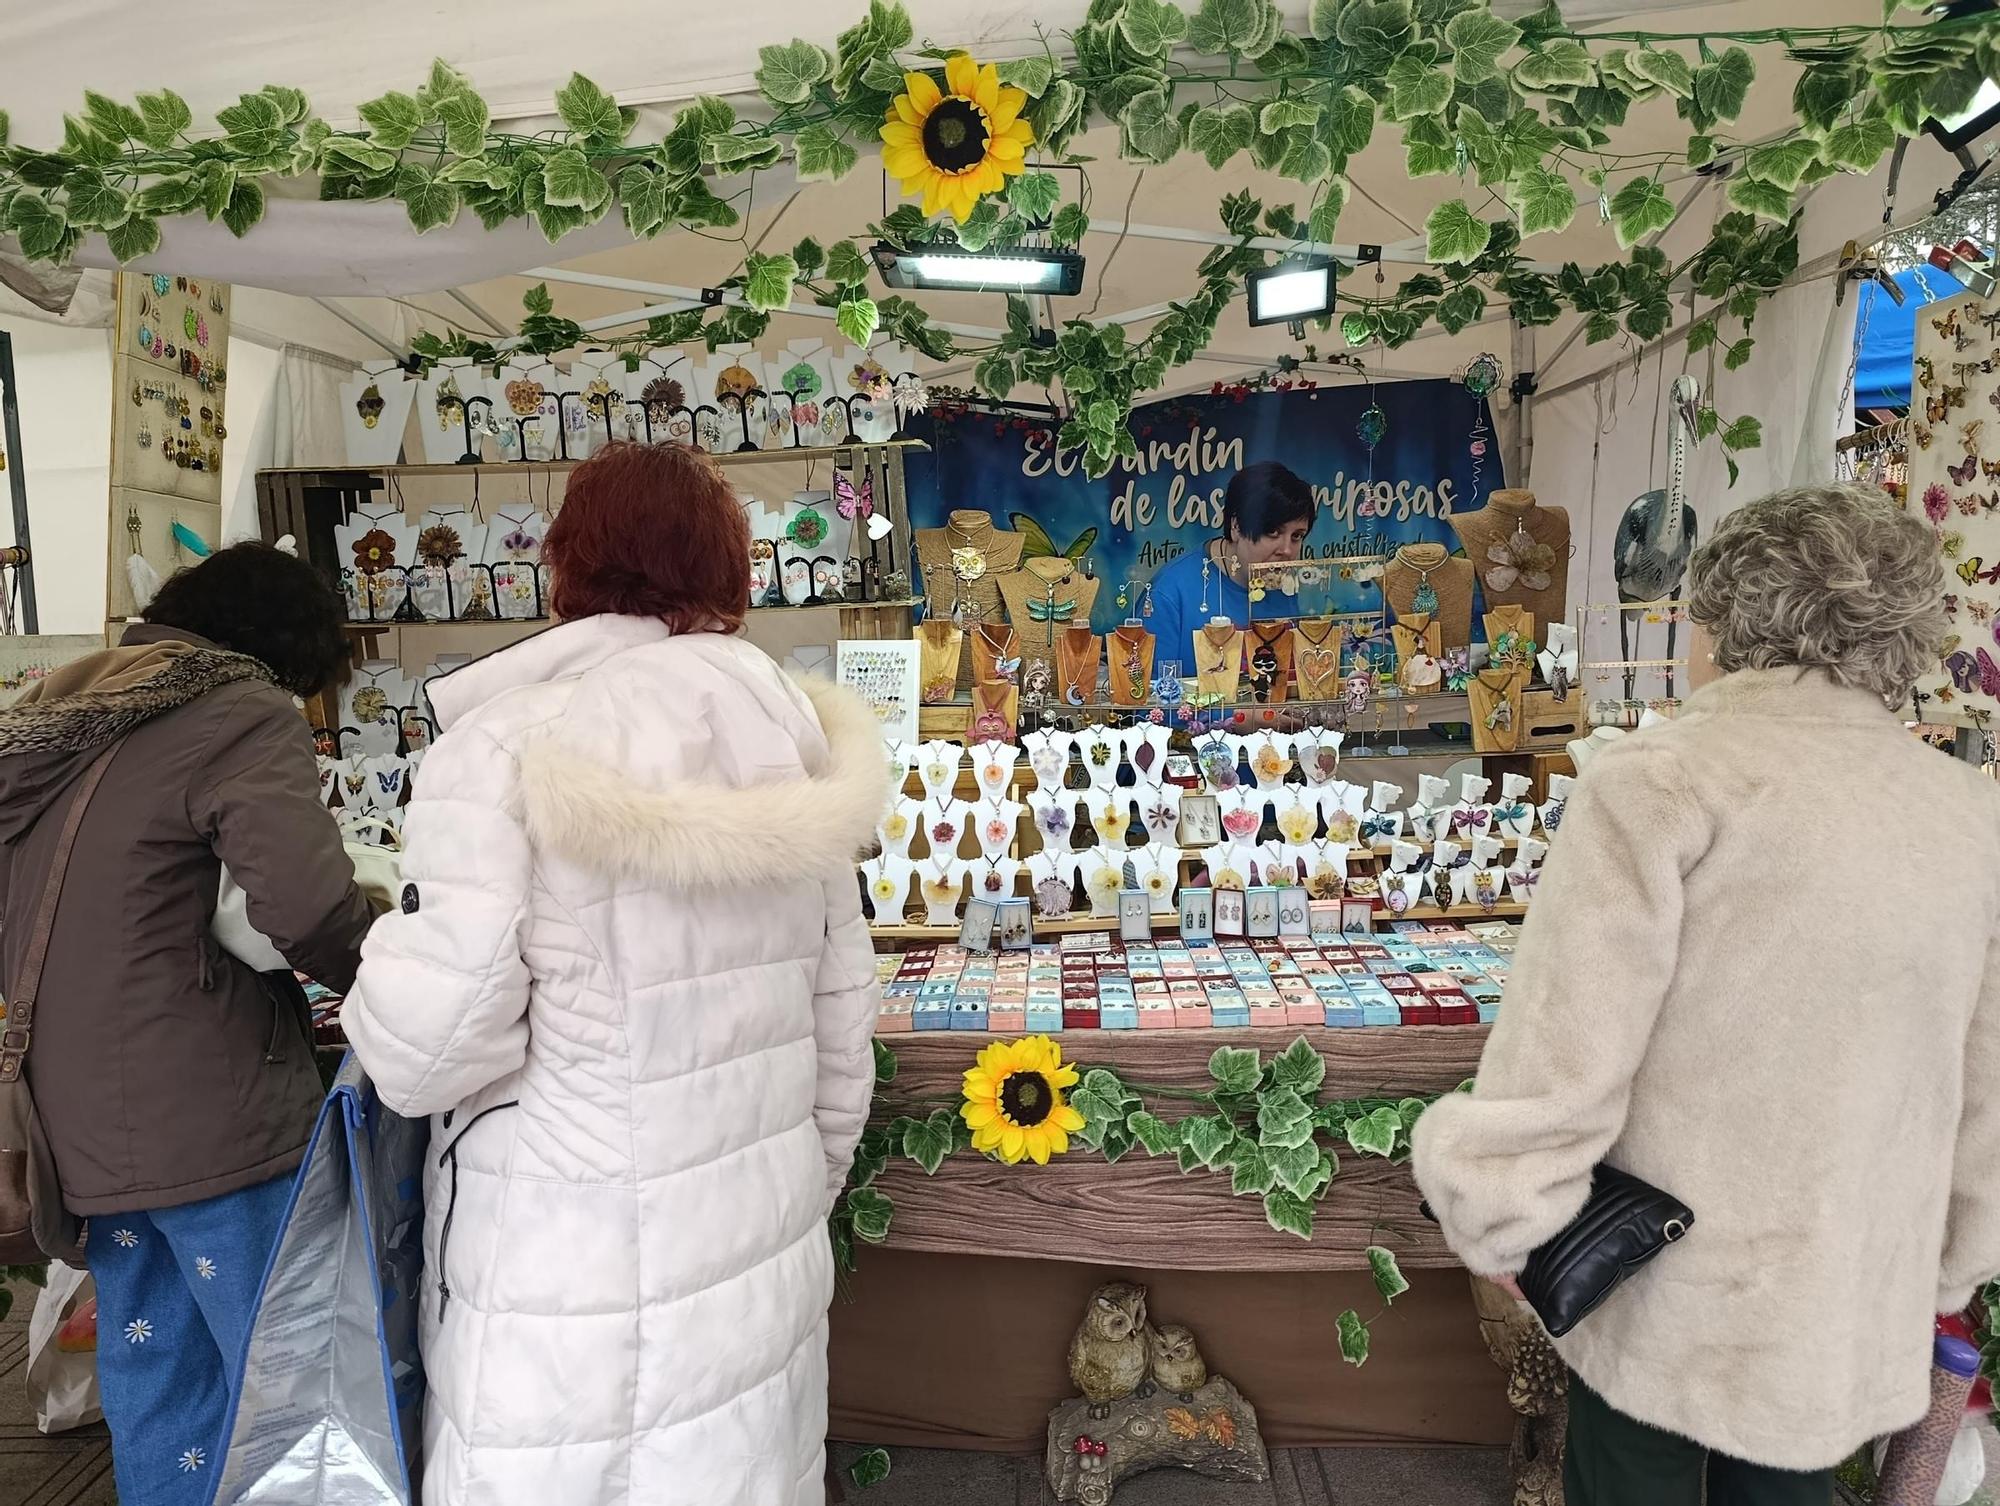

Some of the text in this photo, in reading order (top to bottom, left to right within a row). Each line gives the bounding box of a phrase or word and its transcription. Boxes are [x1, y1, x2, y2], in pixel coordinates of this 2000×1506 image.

[1110, 471, 1458, 532] de las riposas
